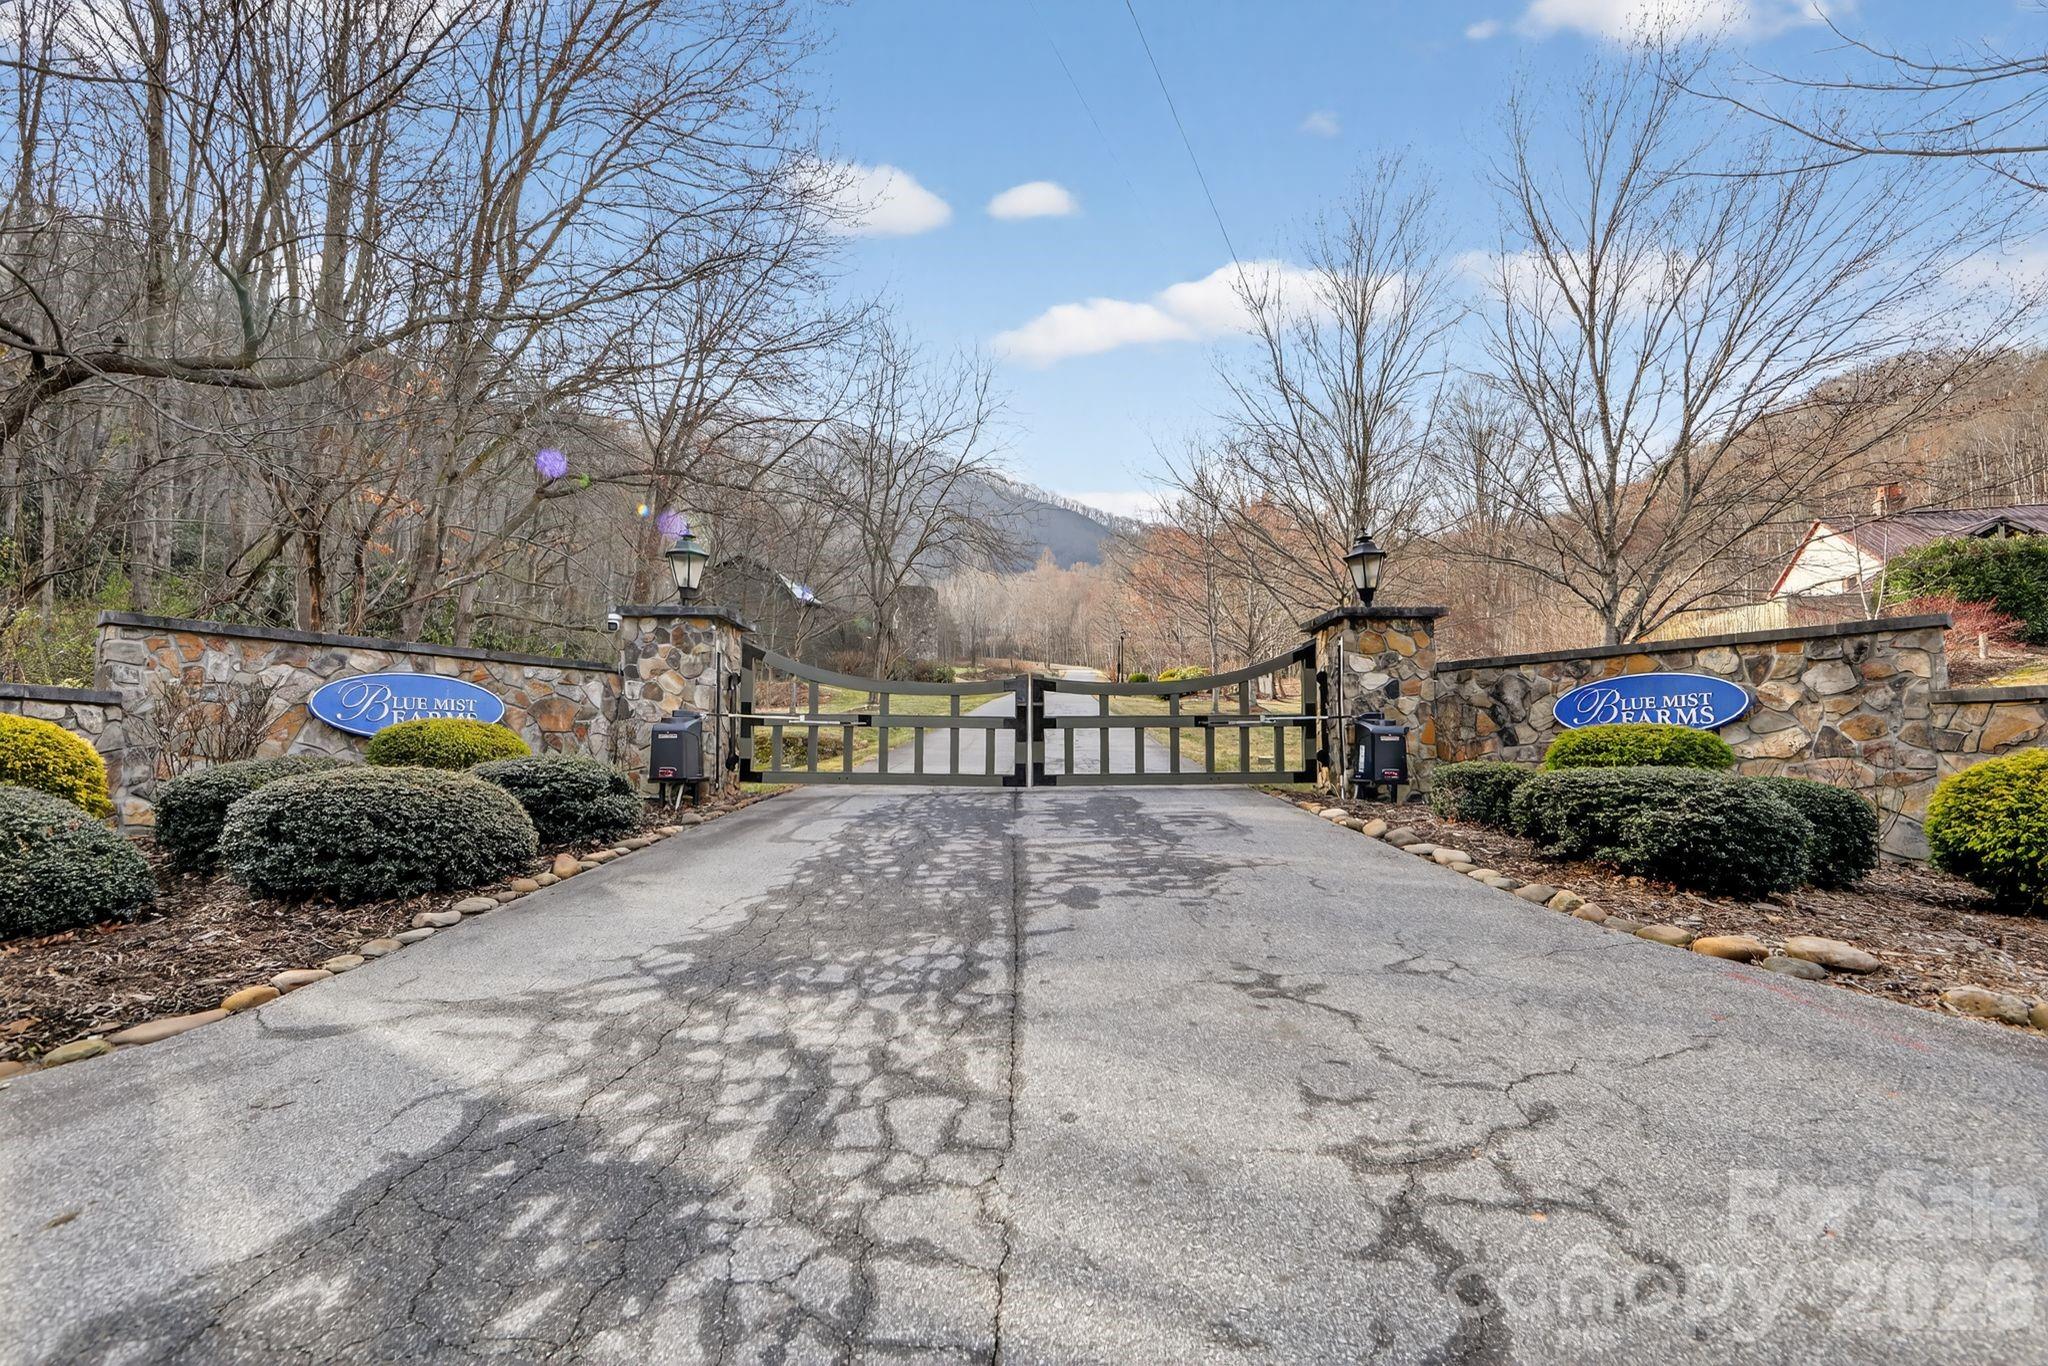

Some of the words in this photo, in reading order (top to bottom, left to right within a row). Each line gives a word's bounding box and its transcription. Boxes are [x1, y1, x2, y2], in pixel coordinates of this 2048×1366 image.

[434, 698, 478, 712] MIST
[1661, 692, 1713, 708] MIST
[1620, 706, 1715, 724] FARMS
